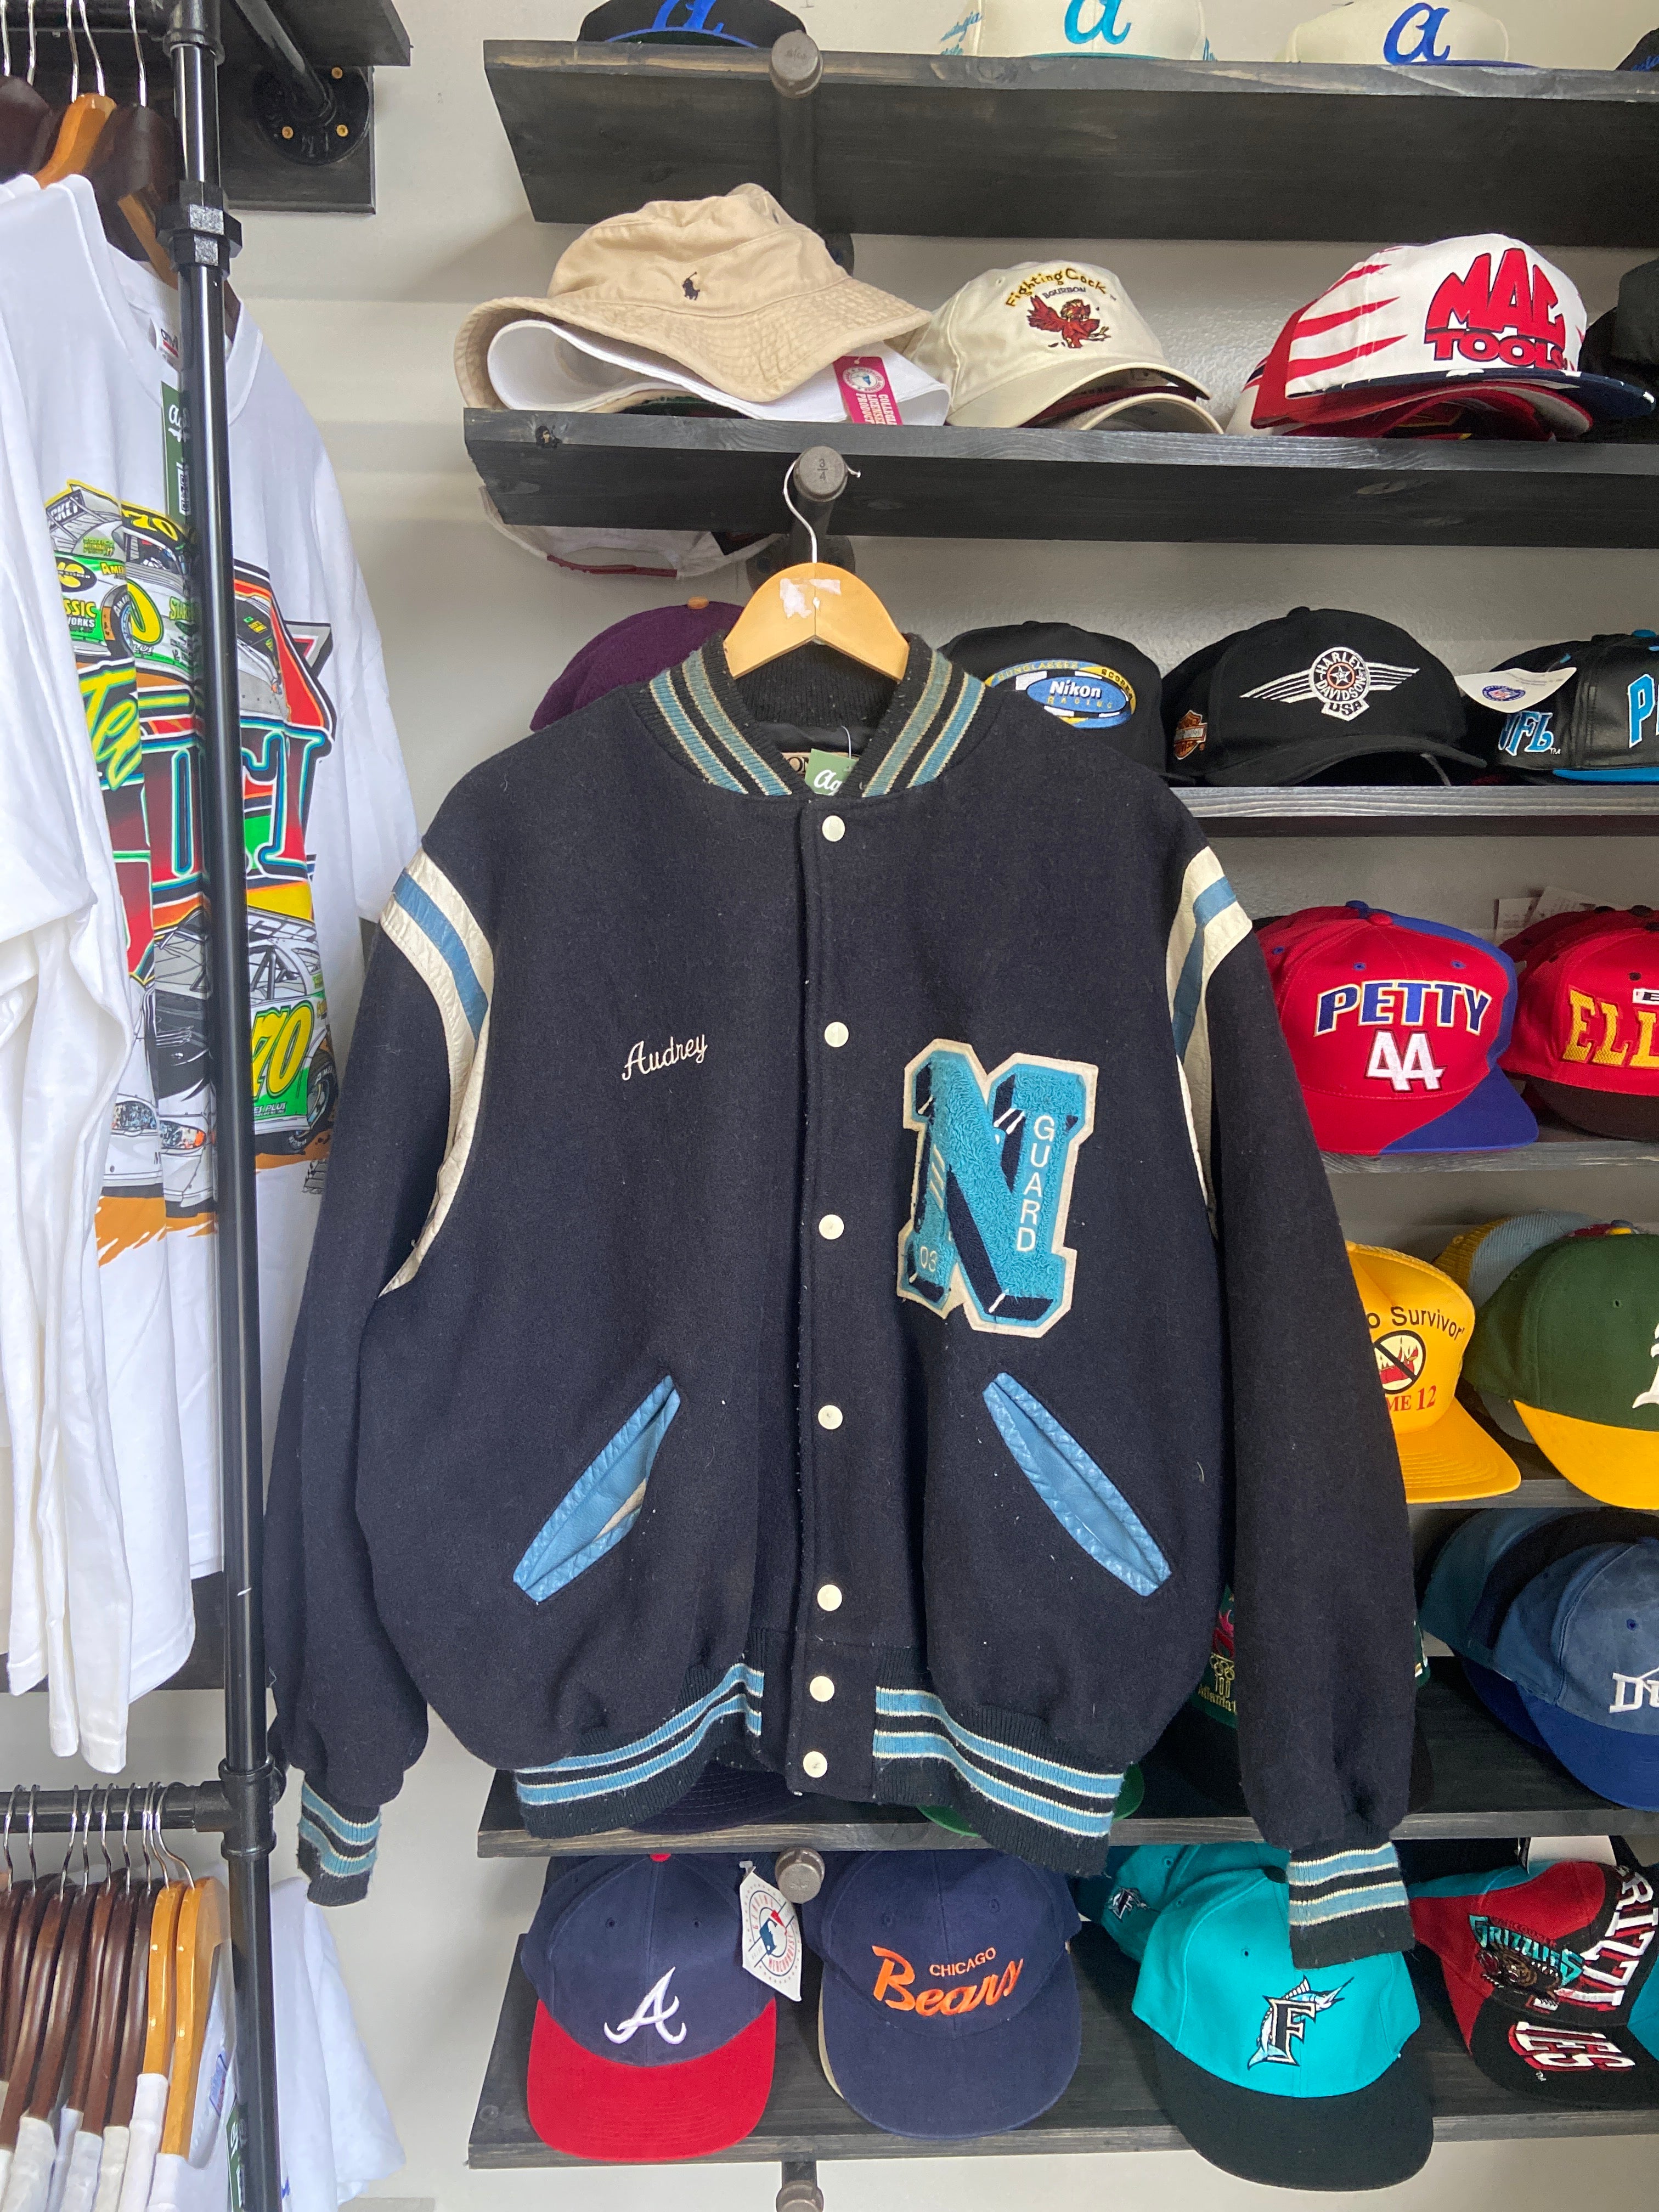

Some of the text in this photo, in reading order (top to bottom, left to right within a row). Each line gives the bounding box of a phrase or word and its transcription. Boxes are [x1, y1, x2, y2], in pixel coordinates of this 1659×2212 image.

[1005, 268, 1107, 307] Fighting Cock
[1042, 286, 1086, 299] BOURBON
[1425, 247, 1566, 350] MAC
[856, 393, 876, 424] PRODUCT
[997, 660, 1079, 681] SUNGLASSES
[1315, 651, 1364, 675] HARLEY
[1047, 696, 1113, 709] RACING
[1049, 680, 1102, 699] Nikon
[1315, 675, 1367, 701] DAVIDSON
[1328, 701, 1362, 715] USA
[1313, 979, 1492, 1036] PETTY
[622, 1034, 708, 1081] Audrey
[1365, 1029, 1446, 1093] 44
[898, 1039, 1098, 1338] N
[1015, 1115, 1056, 1252] GUARD
[1415, 1385, 1437, 1411] 12
[929, 1946, 997, 1977] CHICAGO
[872, 1945, 1024, 2017] Bears
[603, 1966, 687, 2045] A
